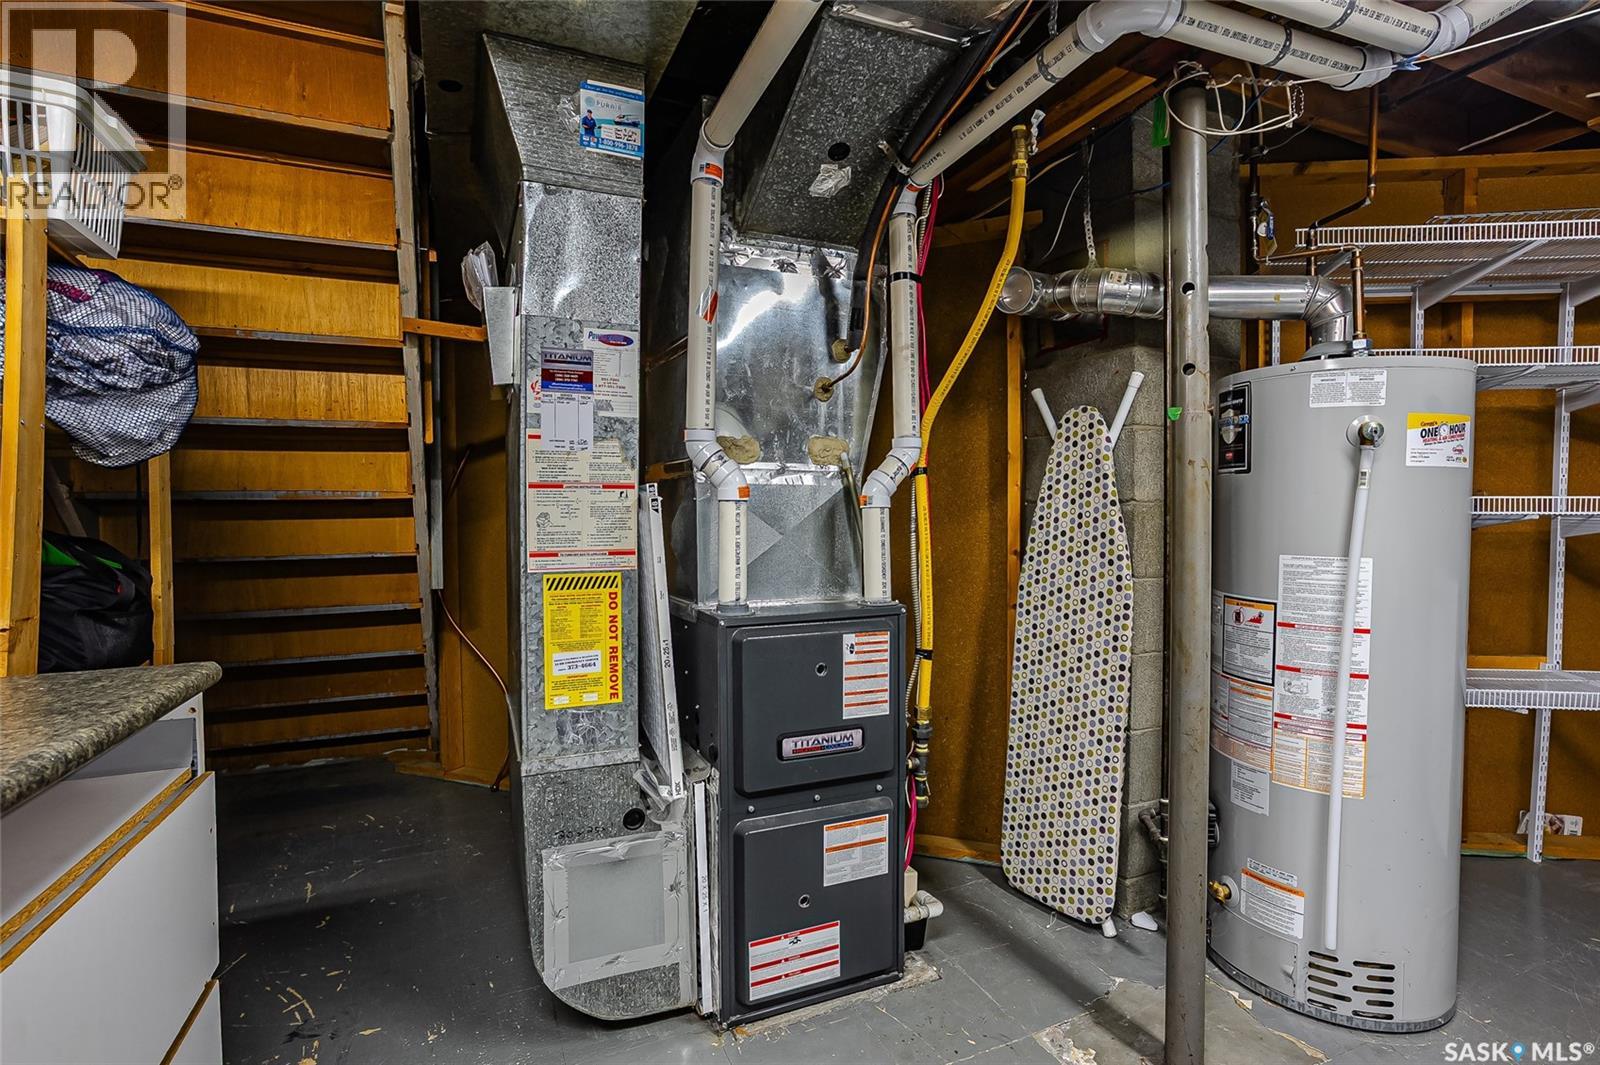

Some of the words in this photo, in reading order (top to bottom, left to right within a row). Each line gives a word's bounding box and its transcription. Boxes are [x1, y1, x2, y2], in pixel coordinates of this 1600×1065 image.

[544, 351, 592, 362] TITANIUM
[1420, 426, 1440, 439] ONE
[1449, 423, 1466, 434] HOUR
[608, 591, 618, 611] DO
[608, 614, 619, 642] NOT
[609, 646, 619, 700] REMOVE
[792, 733, 854, 748] TITANIUM
[674, 780, 682, 796] HDX
